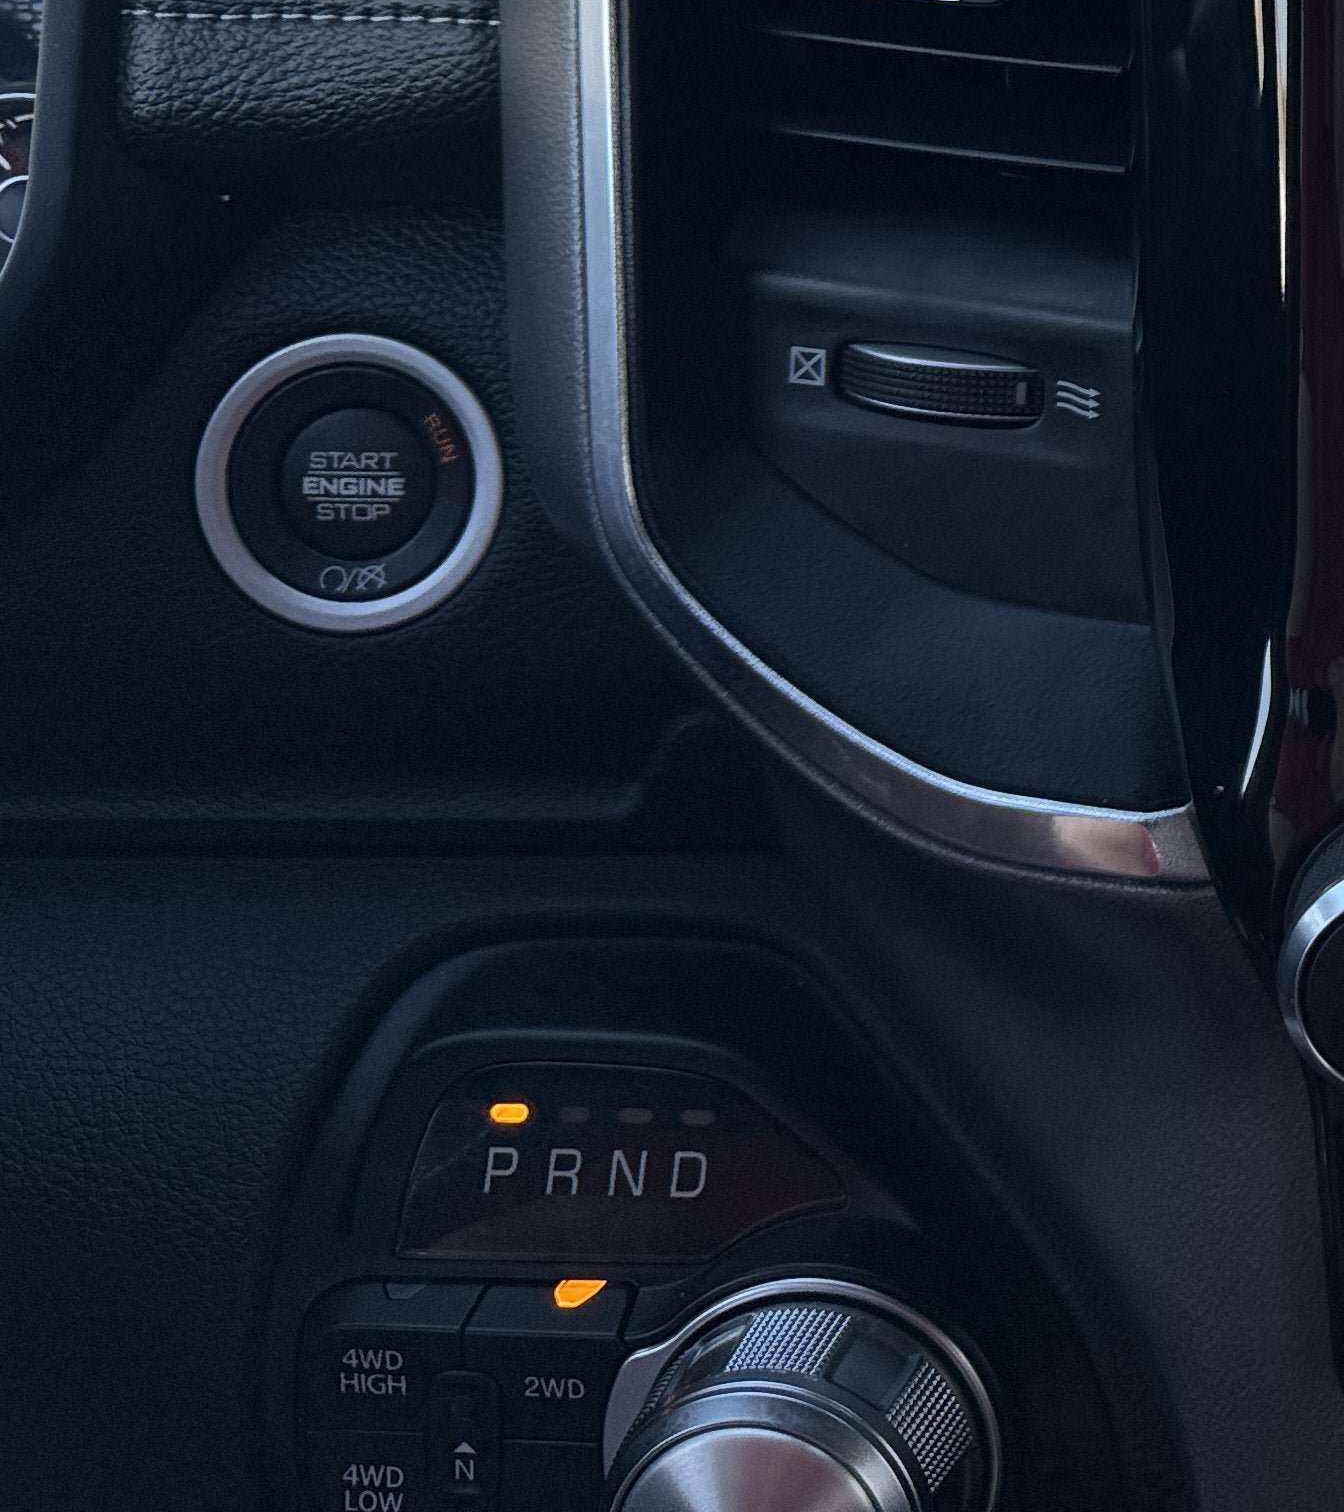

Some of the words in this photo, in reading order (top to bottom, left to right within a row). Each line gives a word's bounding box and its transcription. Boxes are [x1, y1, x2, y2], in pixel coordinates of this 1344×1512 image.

[423, 411, 457, 464] RUN
[310, 451, 397, 469] START
[303, 477, 404, 495] ENGINE
[316, 503, 390, 521] STOP
[342, 1349, 403, 1370] 4WD
[340, 1372, 406, 1395] HIGH
[525, 1377, 584, 1399] 2WD
[343, 1464, 403, 1488] 4WD
[455, 1459, 474, 1480] N
[345, 1490, 403, 1512] LOW
